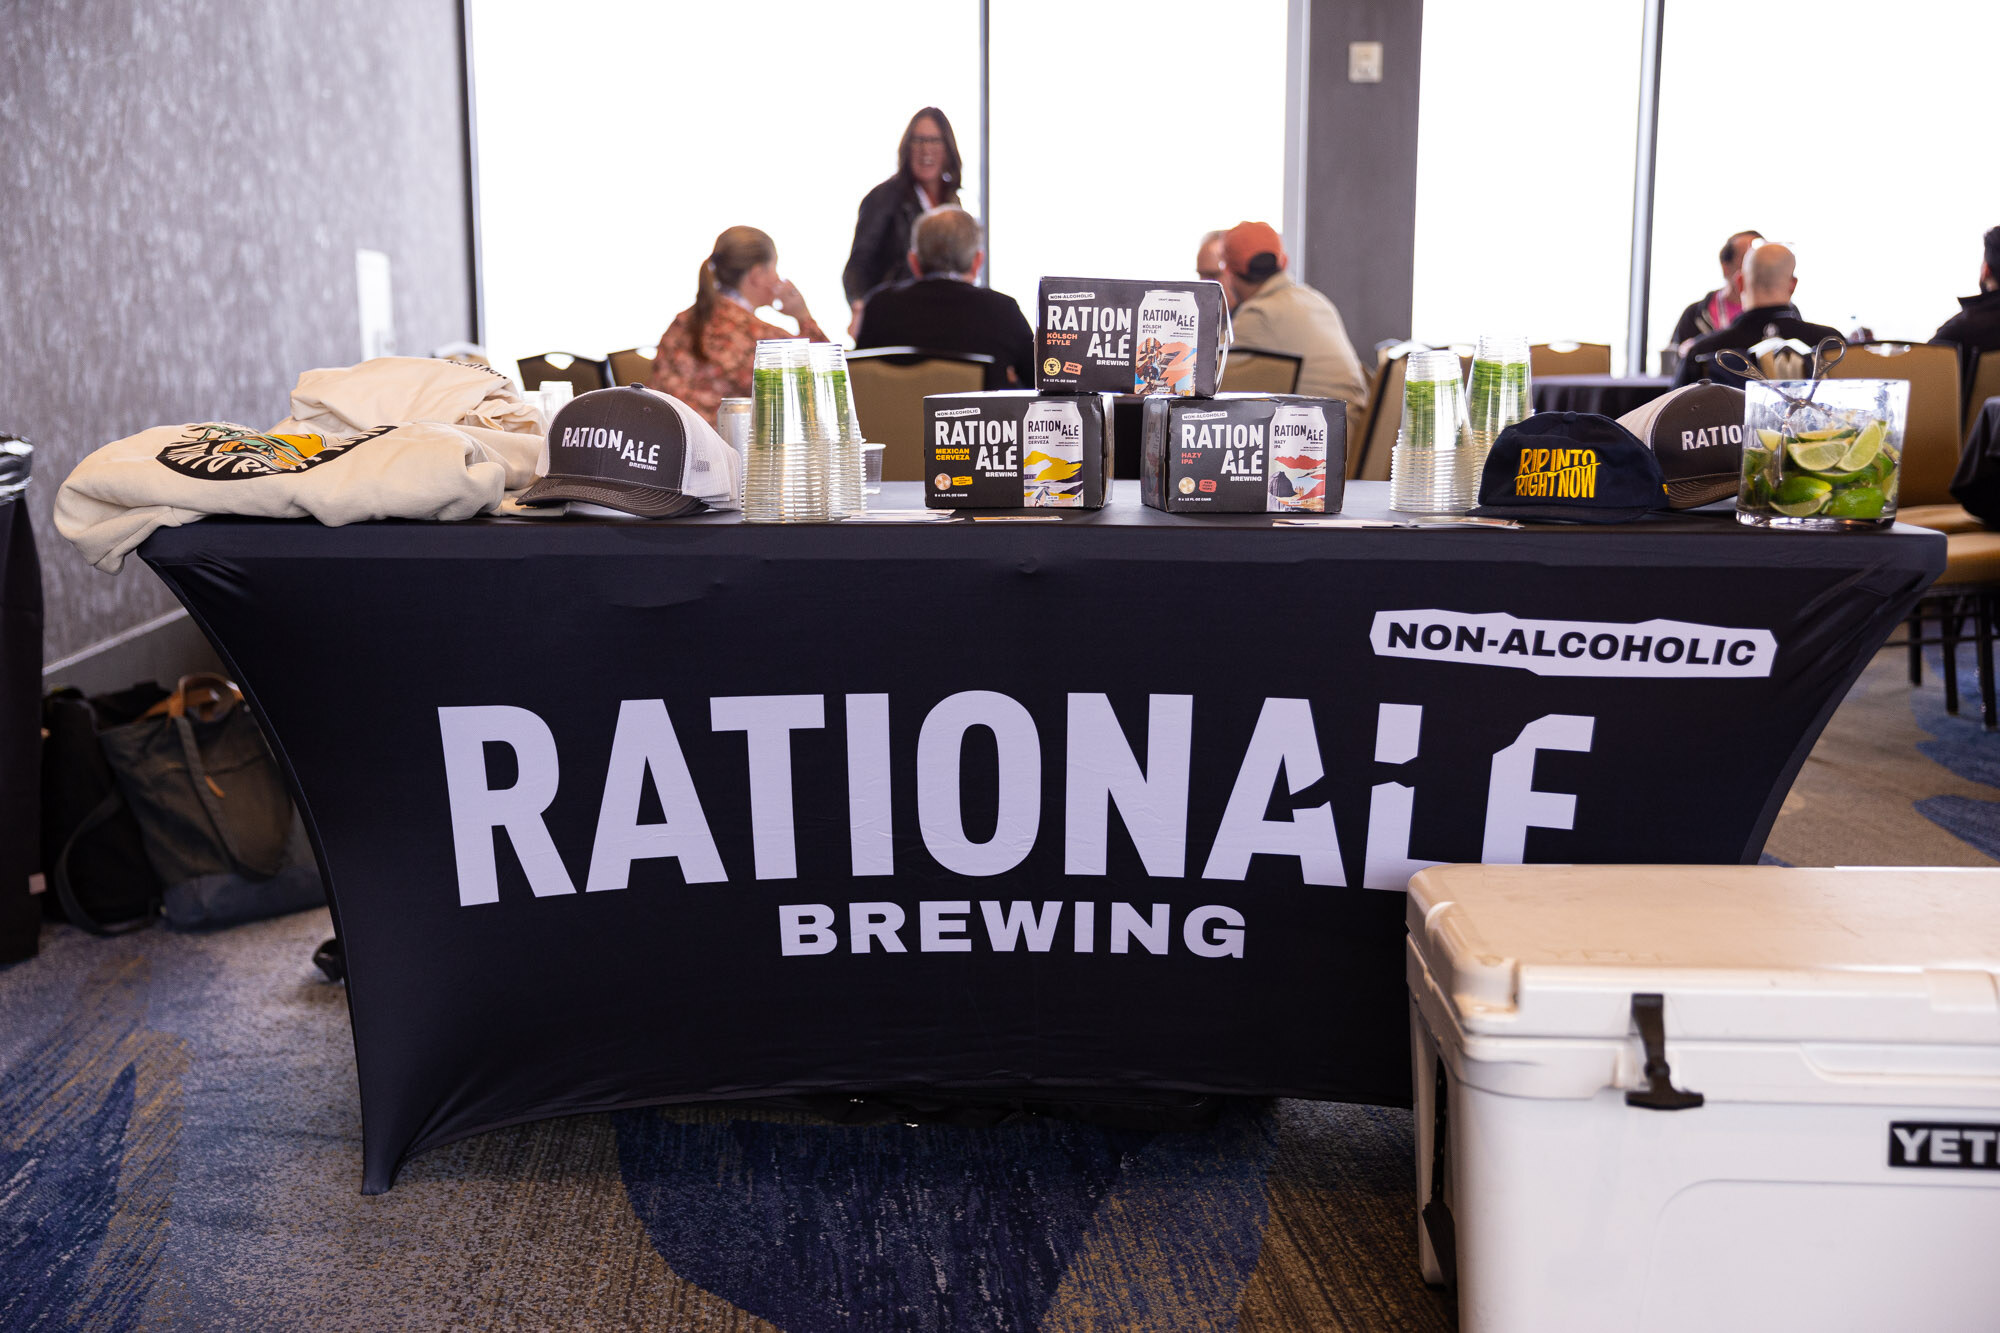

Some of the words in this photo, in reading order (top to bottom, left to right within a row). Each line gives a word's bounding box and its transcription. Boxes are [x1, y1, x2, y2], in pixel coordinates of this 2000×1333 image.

[1047, 305, 1132, 333] RATION
[1046, 332, 1078, 340] KÖLSCH
[1086, 333, 1131, 359] ALE
[935, 420, 1018, 446] RATION
[1181, 424, 1264, 449] RATION
[1681, 424, 1746, 451] RATIO
[975, 446, 1018, 470] ALE
[1220, 449, 1263, 475] ALE
[1518, 448, 1550, 474] RIP
[1550, 448, 1596, 472] INTO
[1515, 471, 1557, 497] RIGHT
[1557, 464, 1598, 499] NOW
[1387, 622, 1757, 667] NON-ALCOHOLIC
[779, 900, 1246, 959] BREWING
[1893, 1127, 2000, 1165] YET
